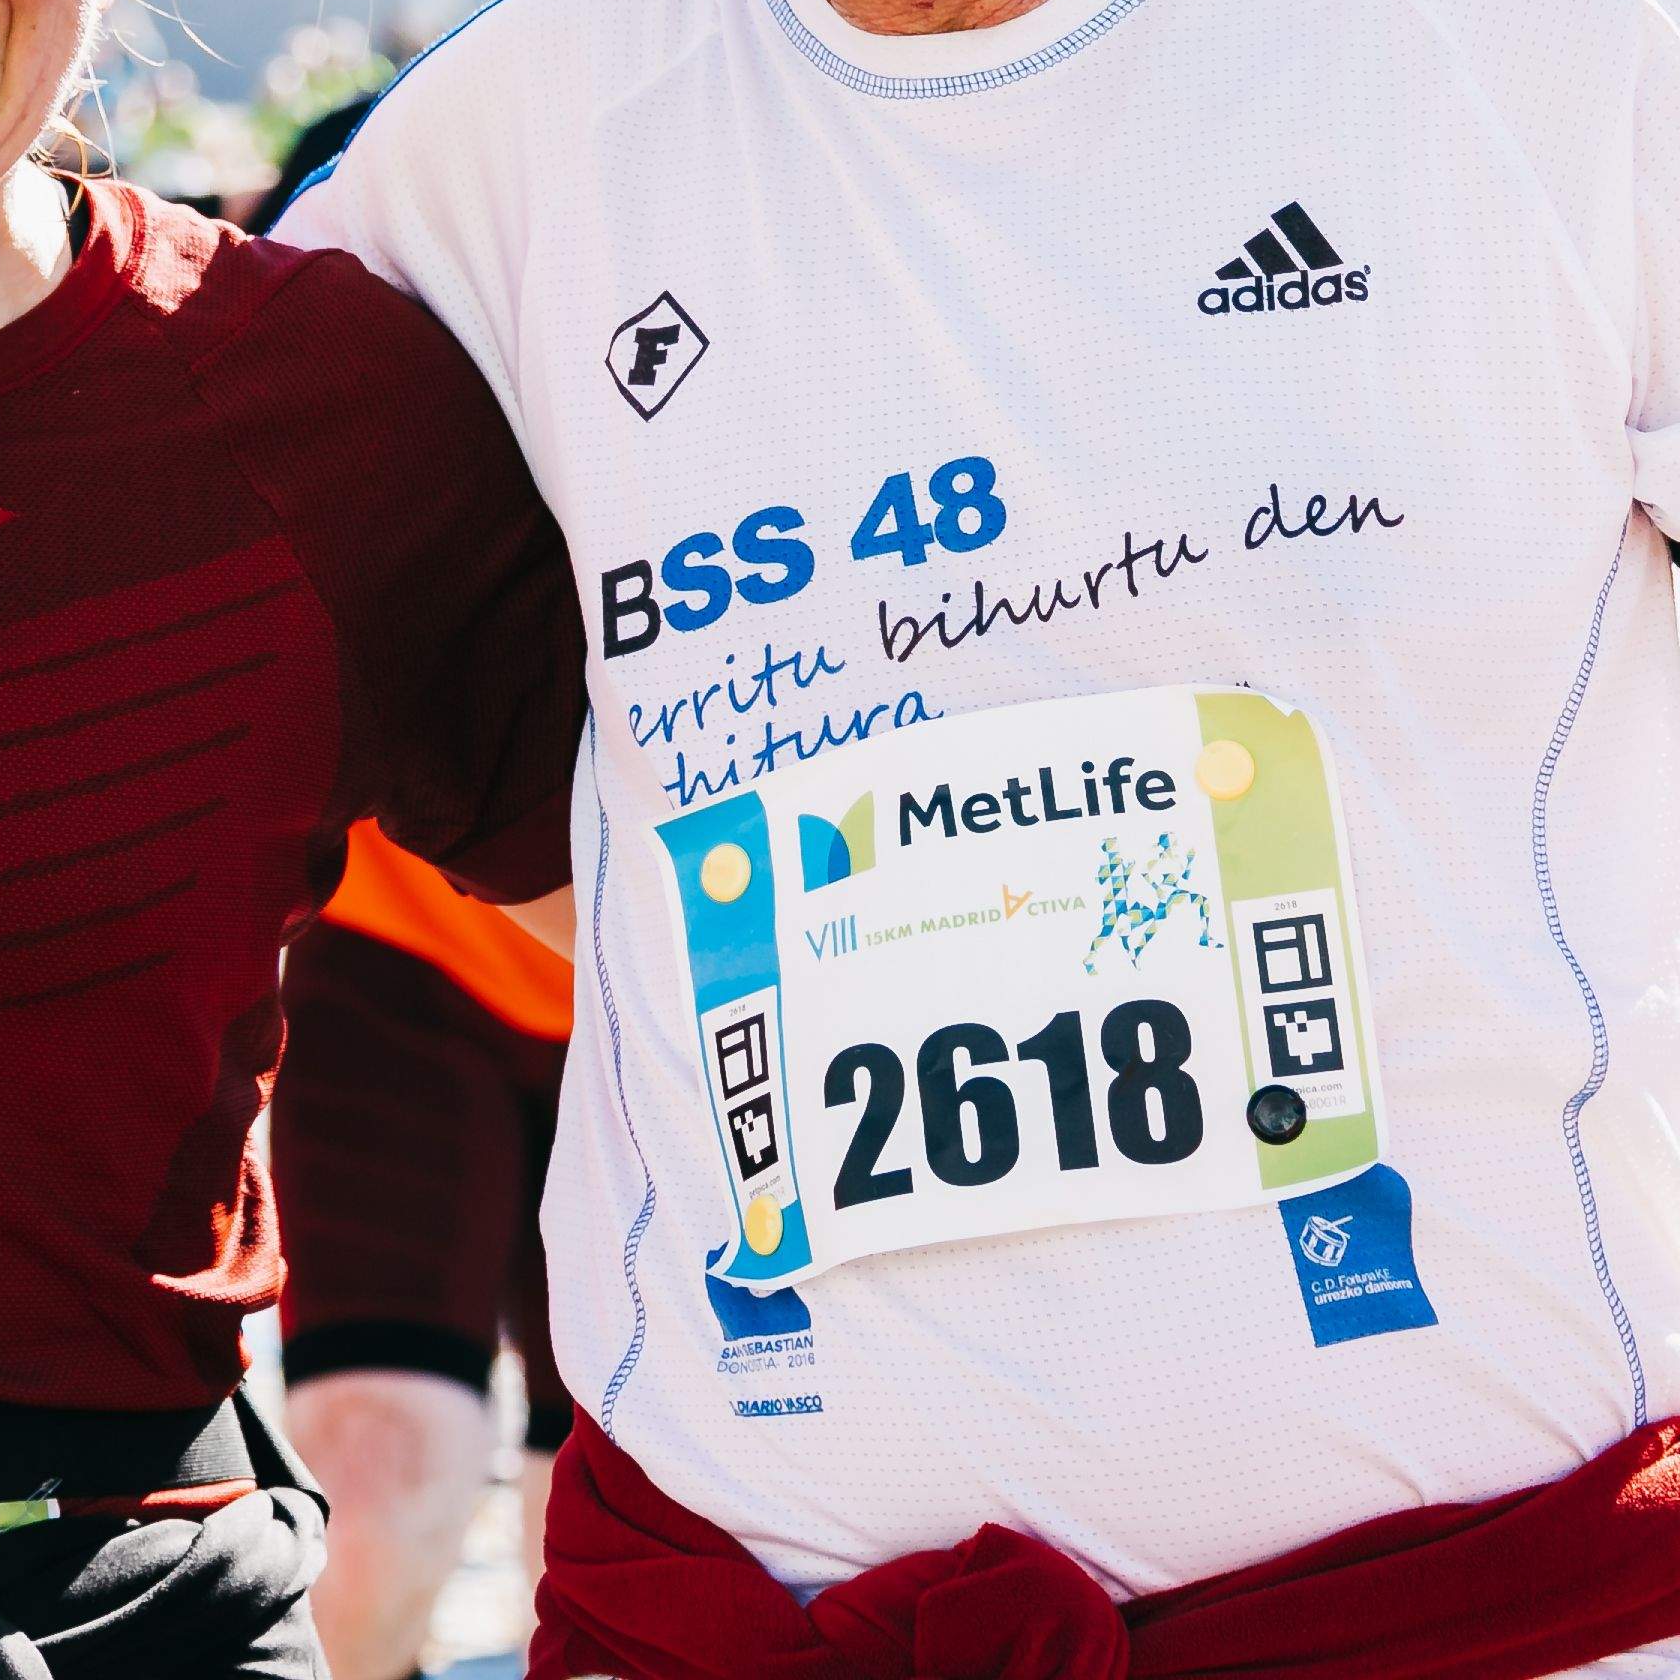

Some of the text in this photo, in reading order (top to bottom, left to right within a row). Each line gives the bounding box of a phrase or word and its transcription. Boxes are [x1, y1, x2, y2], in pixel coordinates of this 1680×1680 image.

[1197, 268, 1368, 315] adidas
[628, 325, 680, 386] F
[602, 456, 1007, 660] BSS 48
[876, 531, 1209, 662] bihurtu
[1242, 483, 1405, 551] den
[899, 756, 1177, 847] MetLife
[1272, 899, 1298, 911] 2618
[804, 914, 858, 963] VIII
[865, 924, 913, 948] 15KM
[920, 908, 1001, 934] MADRID
[822, 998, 1205, 1212] 2618
[787, 1353, 815, 1368] 2016
[737, 1398, 782, 1413] DIARIO
